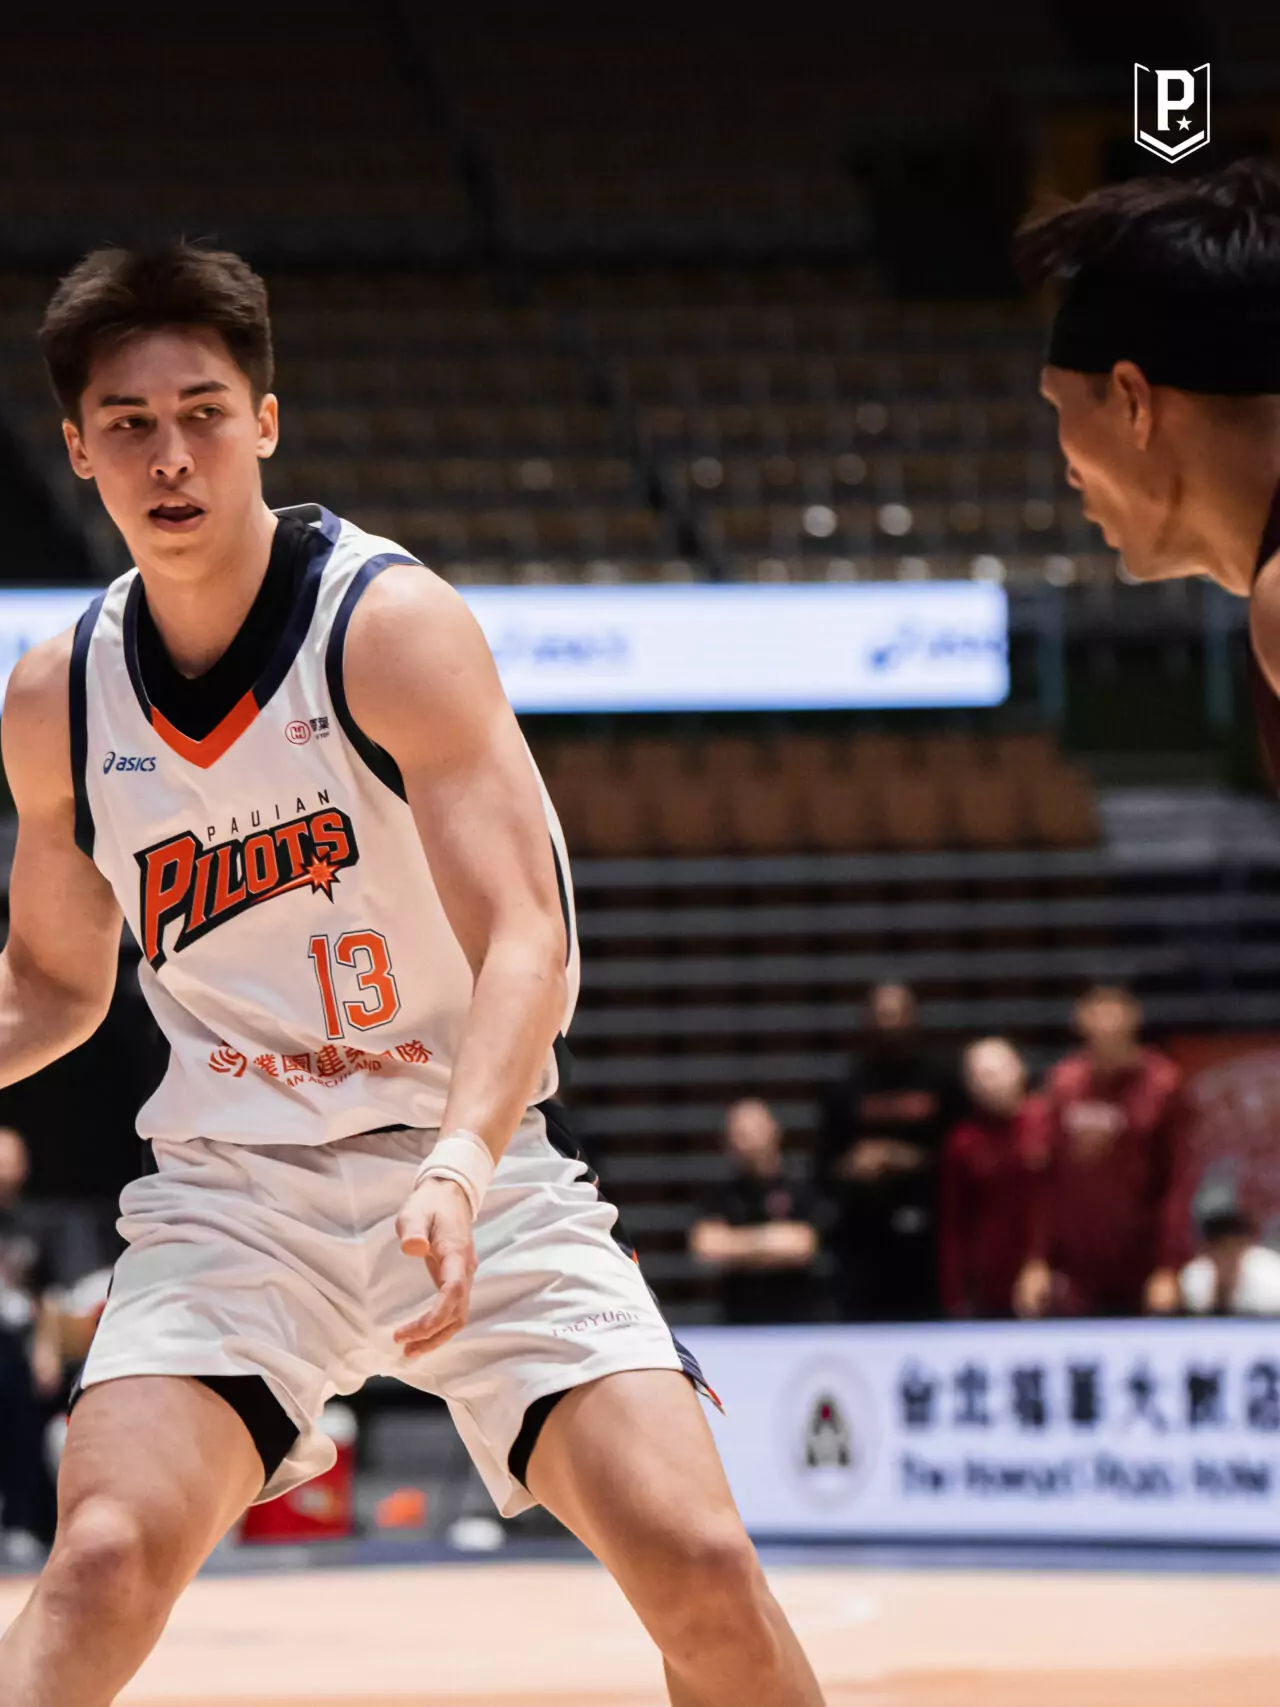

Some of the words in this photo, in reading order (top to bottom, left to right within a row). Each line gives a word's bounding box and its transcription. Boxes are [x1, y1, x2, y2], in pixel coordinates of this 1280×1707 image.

[115, 756, 157, 772] asics
[206, 789, 331, 842] PAUIAN
[133, 806, 360, 974] PILOTS
[307, 928, 402, 1041] 13
